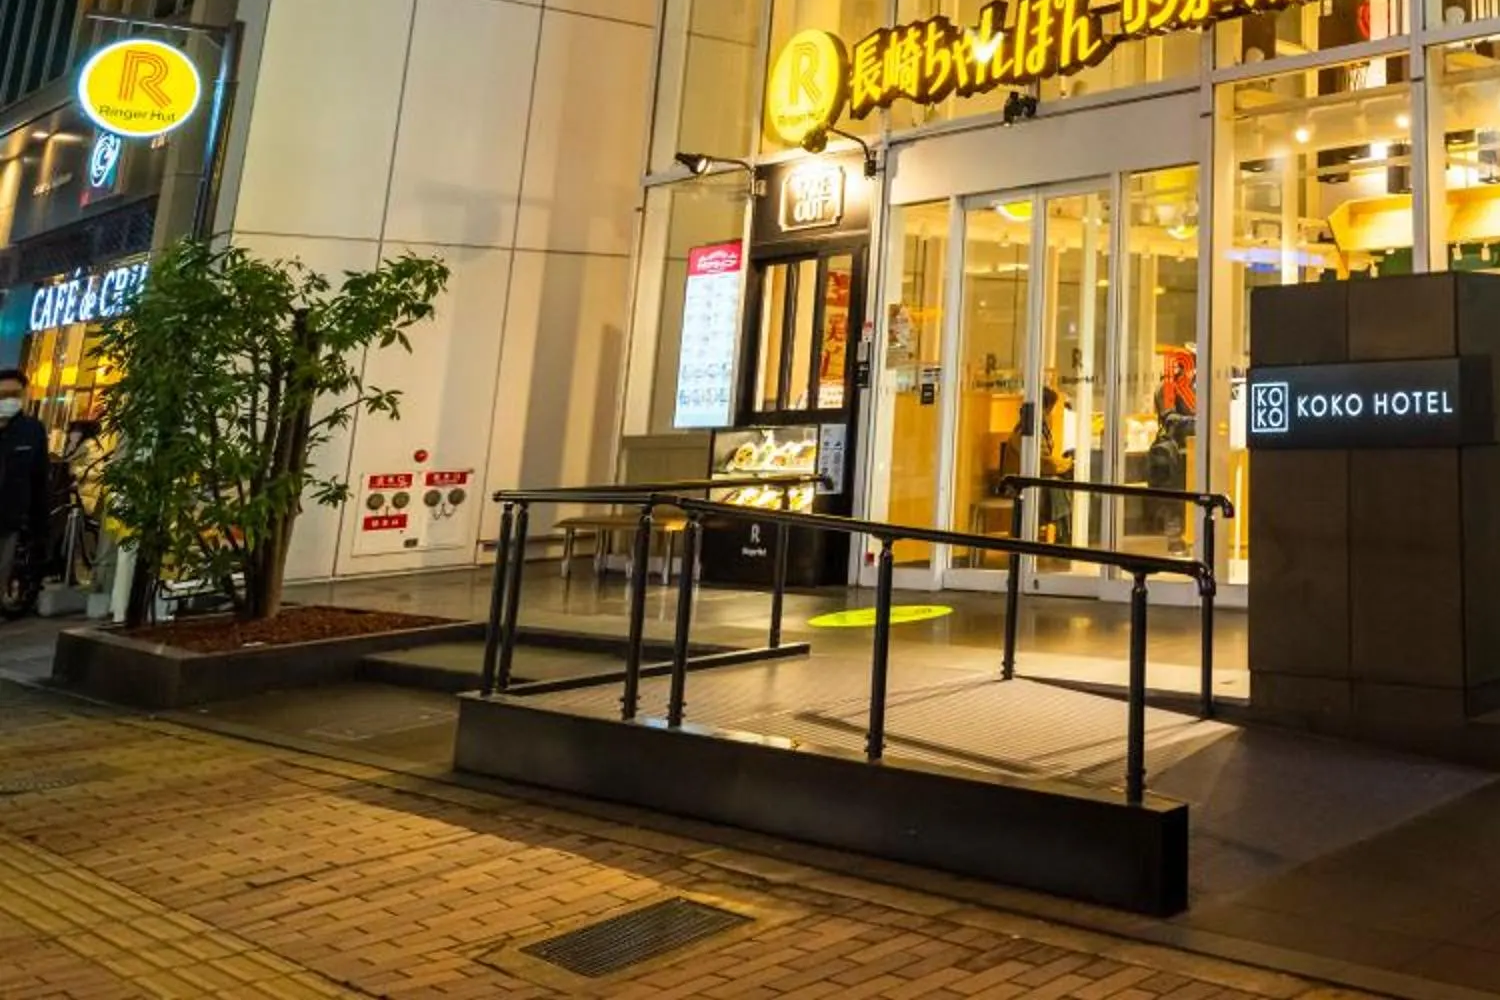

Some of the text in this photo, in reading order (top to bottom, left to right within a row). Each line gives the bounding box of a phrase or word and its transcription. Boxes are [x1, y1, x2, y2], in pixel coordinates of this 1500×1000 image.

[118, 50, 172, 109] R
[788, 41, 823, 106] R
[99, 105, 176, 123] Ringer Hut
[30, 266, 81, 331] CAFÉ
[1257, 387, 1283, 407] KO
[1297, 391, 1454, 417] KOKO HOTEL
[1257, 407, 1283, 428] KO
